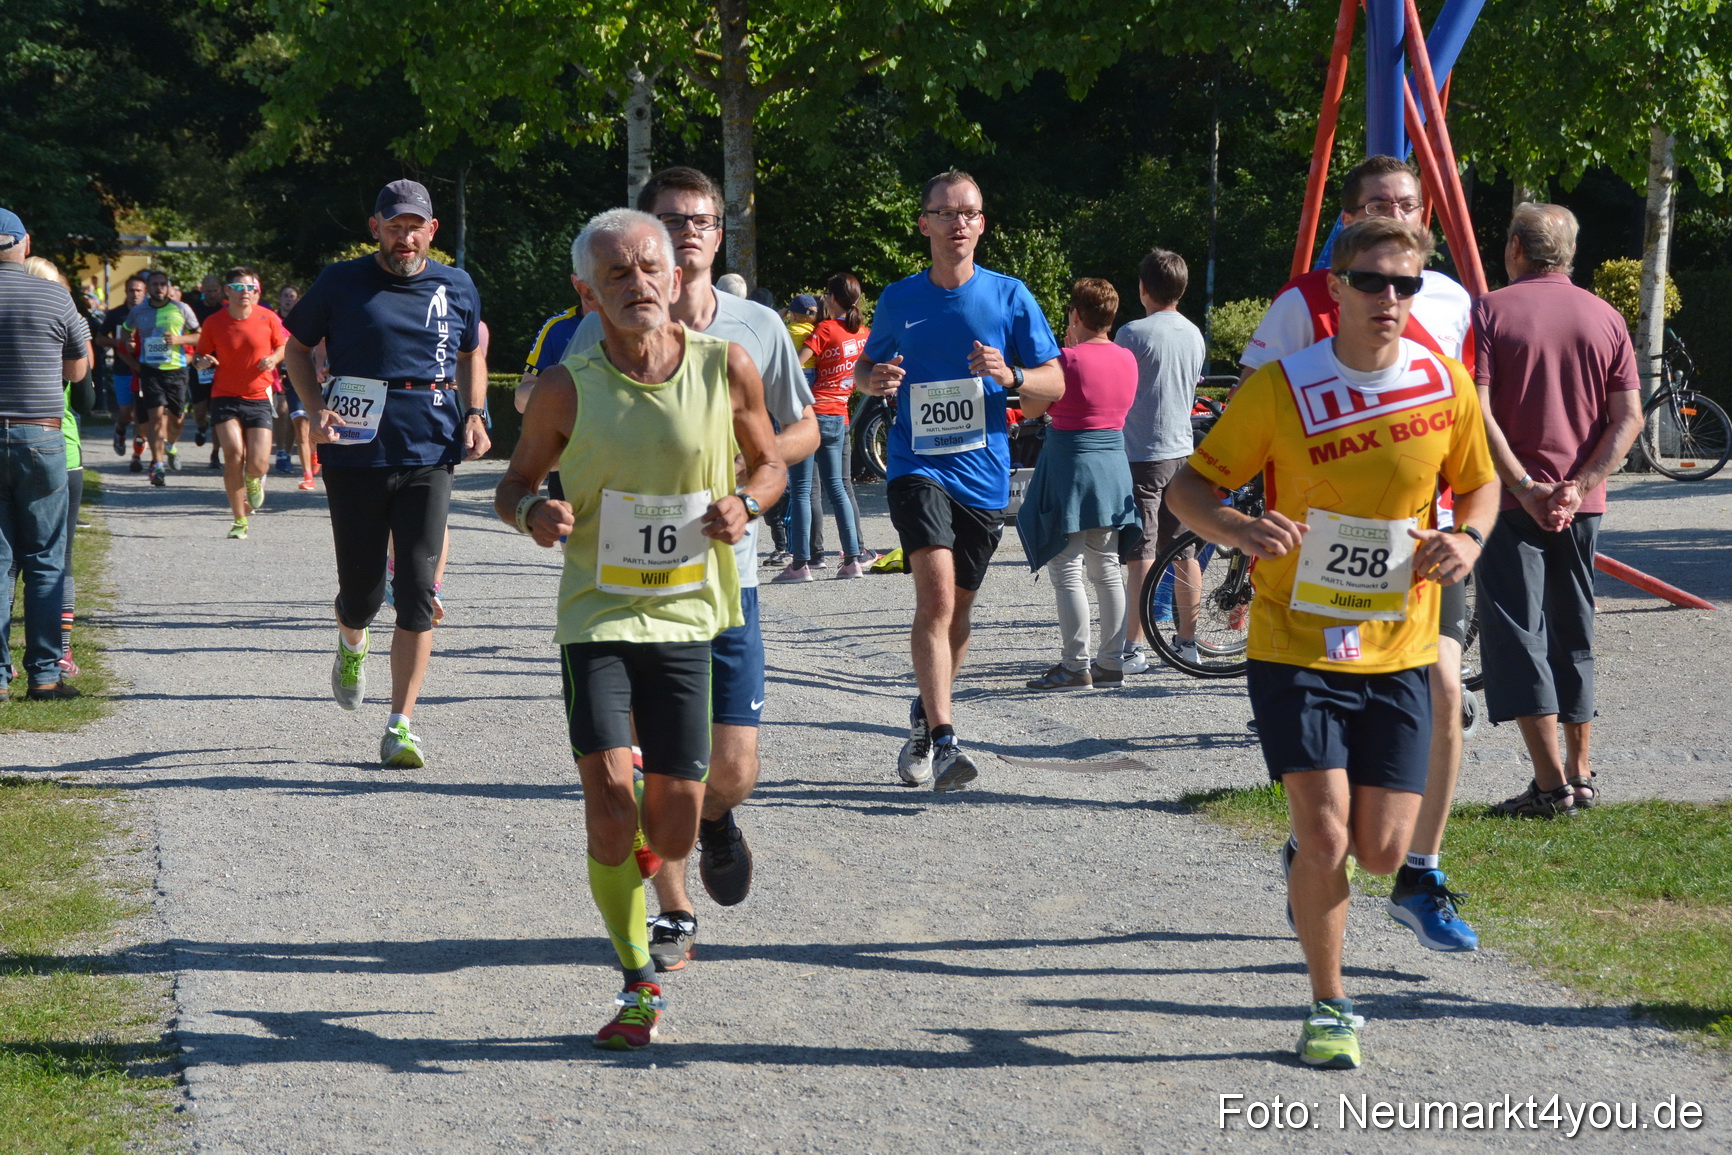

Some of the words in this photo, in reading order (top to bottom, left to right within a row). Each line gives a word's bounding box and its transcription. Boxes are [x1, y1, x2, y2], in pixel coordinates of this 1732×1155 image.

[340, 382, 366, 393] BOCK
[927, 386, 961, 398] BOCK
[331, 394, 375, 418] 2387
[920, 399, 974, 425] 2600
[942, 424, 965, 432] Neumarkt
[934, 436, 964, 447] Stefan
[1308, 429, 1382, 466] MAX
[634, 504, 683, 516] BOCK
[1338, 523, 1389, 540] BOCK
[639, 525, 677, 554] 16
[622, 557, 646, 566] PARTL
[648, 556, 680, 566] Neumarkt
[1326, 543, 1390, 579] 258
[641, 571, 670, 585] Willi
[1320, 575, 1344, 586] PARTL
[1346, 580, 1379, 590] Neumarkt
[1330, 593, 1372, 609] Julian
